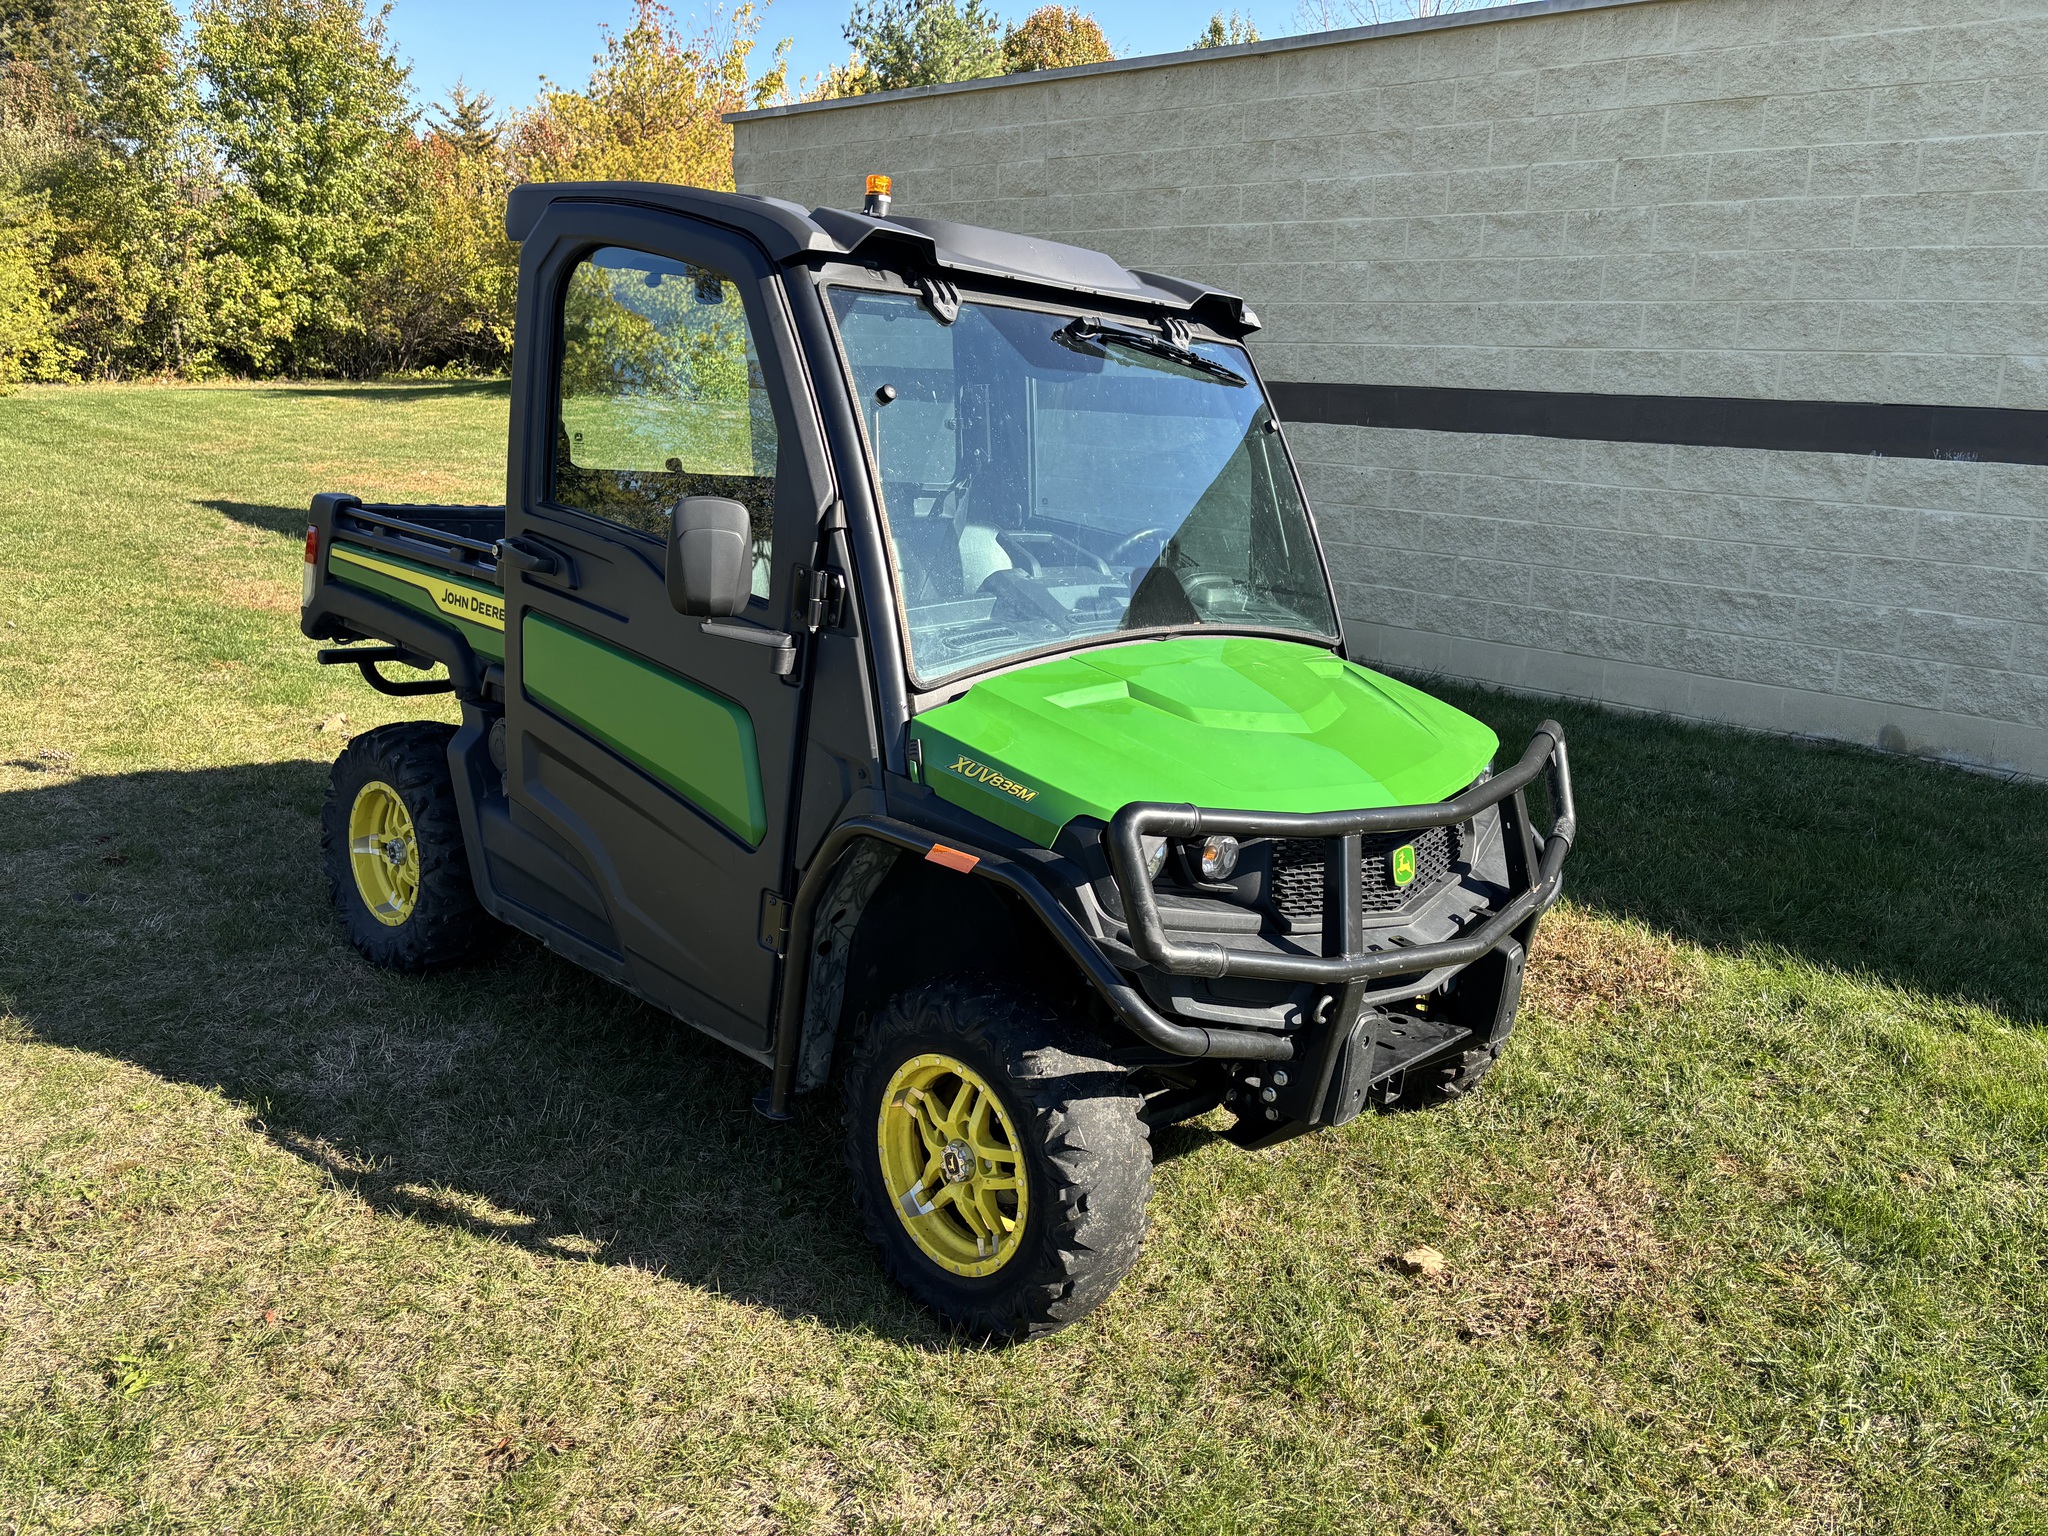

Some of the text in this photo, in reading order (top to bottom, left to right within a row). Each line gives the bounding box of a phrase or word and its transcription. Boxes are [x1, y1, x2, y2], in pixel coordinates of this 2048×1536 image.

[441, 588, 505, 621] JOHN DEERE
[948, 756, 1037, 803] XUV835M
